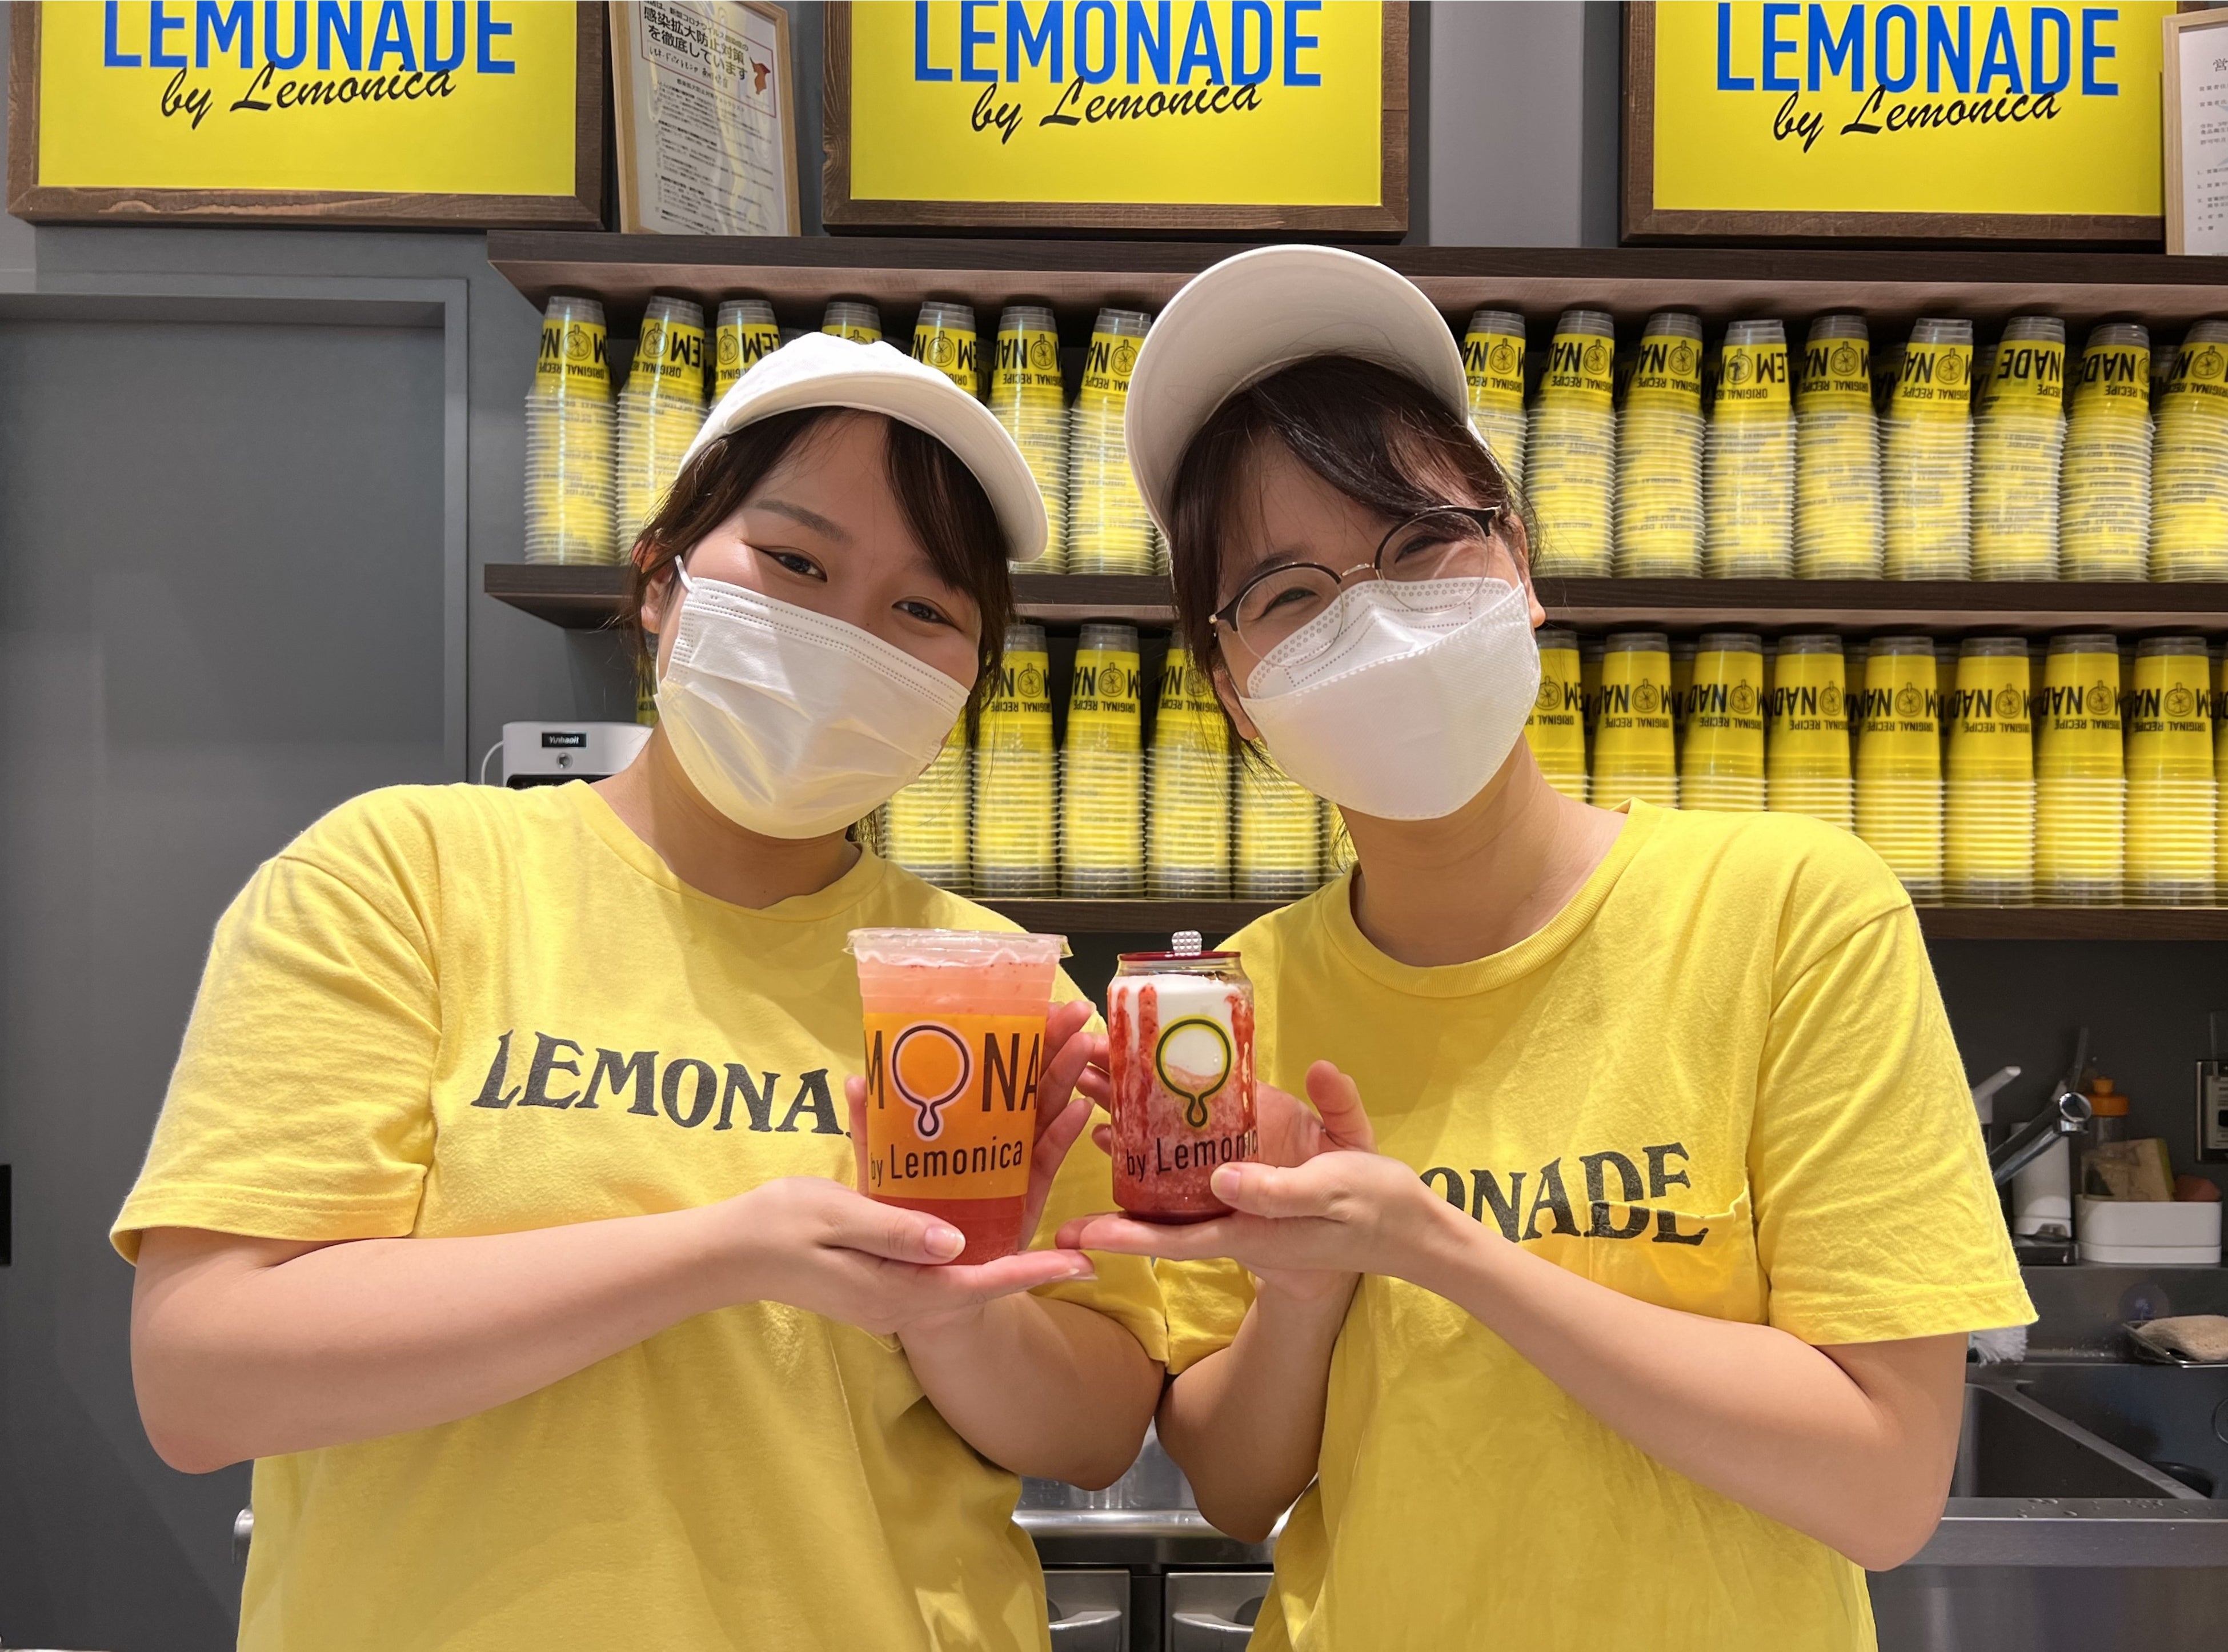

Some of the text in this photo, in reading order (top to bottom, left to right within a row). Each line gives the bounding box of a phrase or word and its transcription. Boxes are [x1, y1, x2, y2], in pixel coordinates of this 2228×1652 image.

[103, 0, 516, 74] LEMONADE
[915, 0, 1322, 87] LEMONADE
[648, 24, 748, 80] を徹底しています
[1716, 2, 2119, 96] LEMONADE
[161, 61, 458, 130] by Lemonica
[971, 75, 1263, 145] by Lemonica
[1773, 83, 2062, 154] by Lemonica
[1003, 373, 1032, 385] RECIPE
[1551, 375, 1582, 388] RECIPE
[1637, 376, 1667, 388] RECIPE
[1728, 388, 1768, 400] ORIGINAL
[1902, 387, 1934, 399] RECIPE
[2106, 384, 2138, 397] RECIPE
[1100, 700, 1136, 713] ORIGINAL
[1537, 715, 1574, 726] ORIGINAL
[1604, 717, 1632, 729] RECIPE
[1699, 717, 1730, 728] RECIPE
[1789, 719, 1821, 731] RECIPE
[2054, 718, 2087, 731] RECIPE
[1965, 722, 1995, 733] RECIPE
[470, 1029, 852, 1138] LEMONA
[871, 1136, 1023, 1188] by Lemonica
[1127, 1148, 1146, 1182] by
